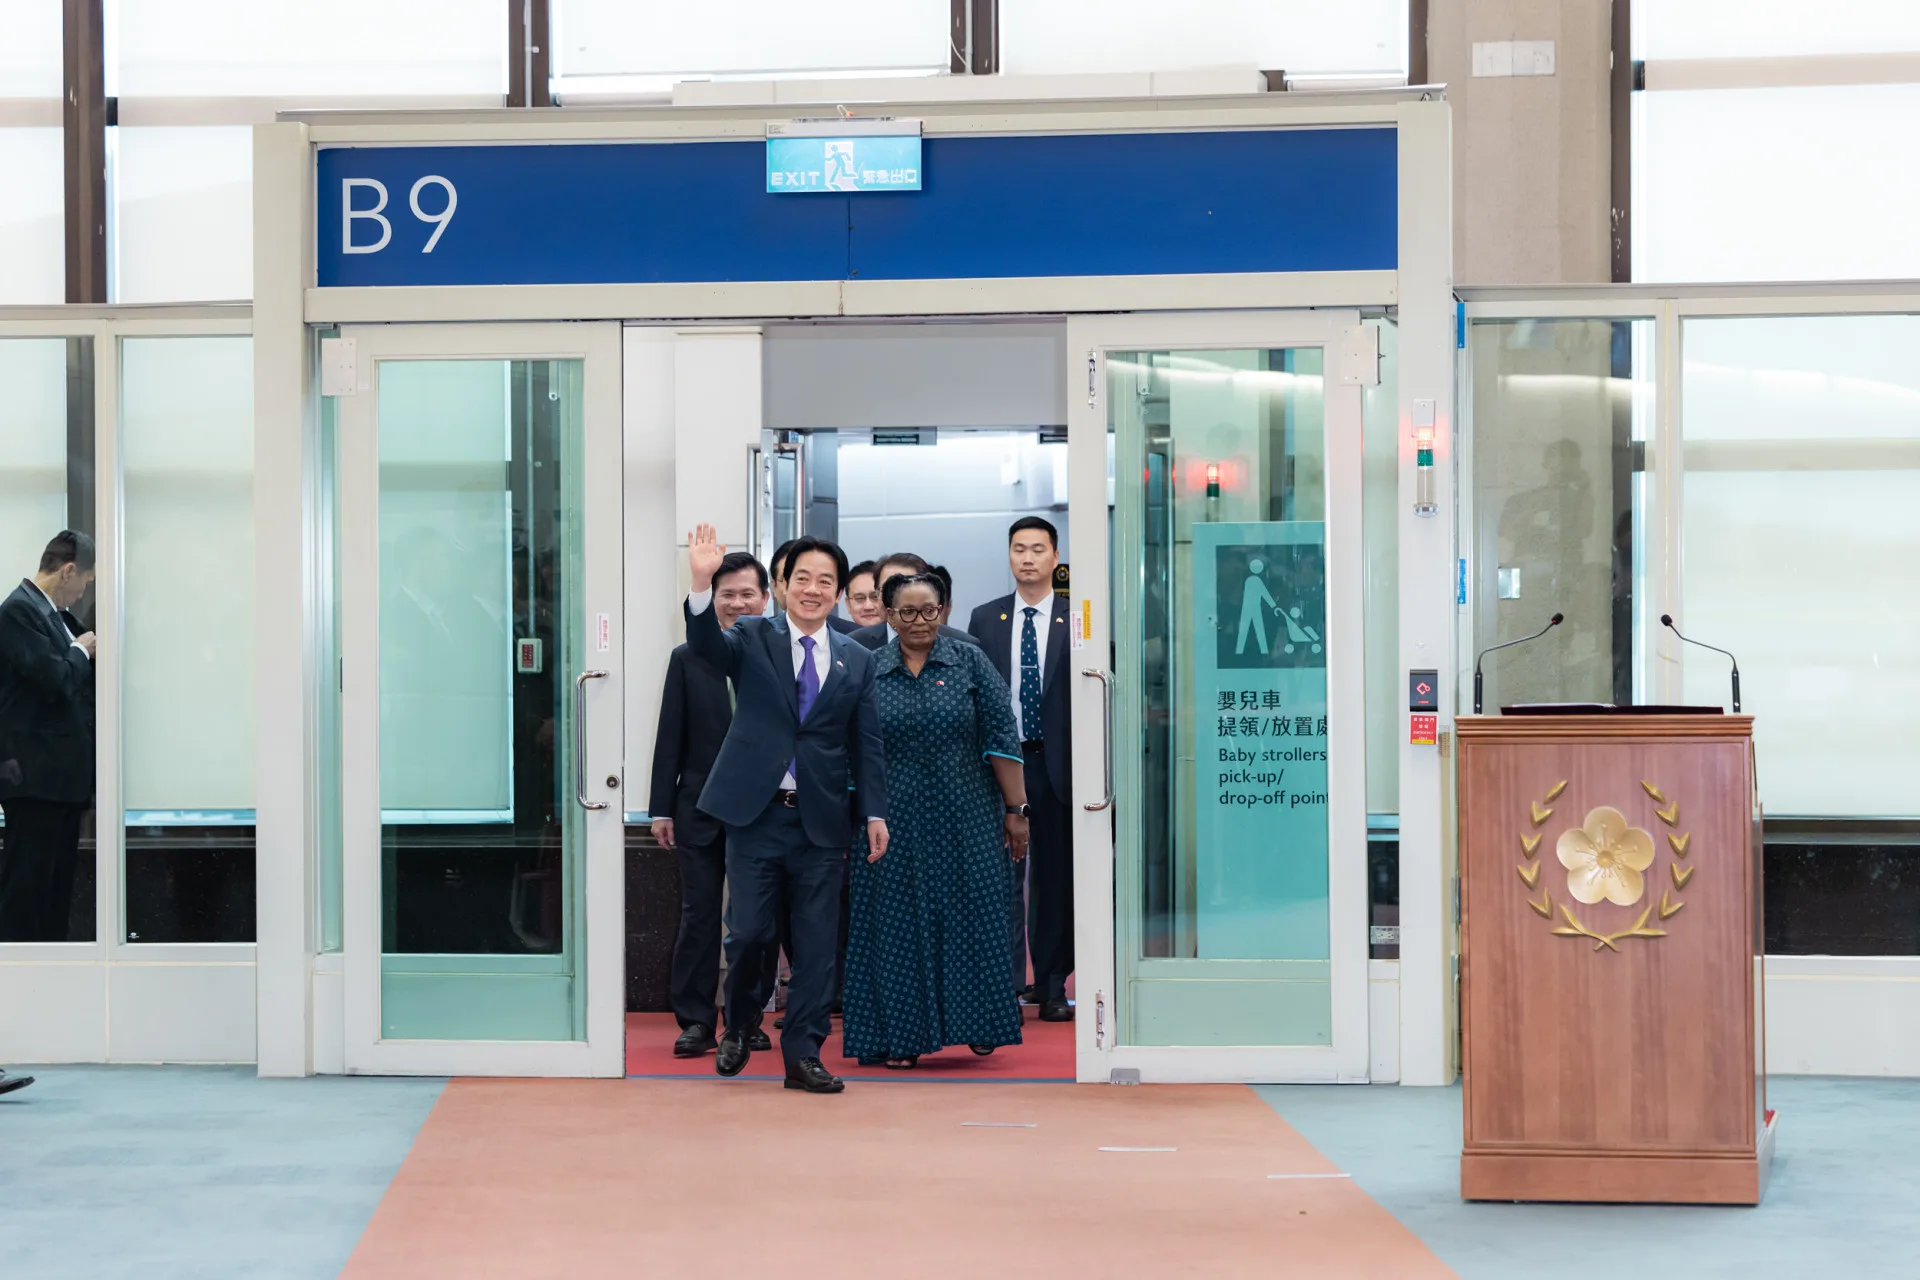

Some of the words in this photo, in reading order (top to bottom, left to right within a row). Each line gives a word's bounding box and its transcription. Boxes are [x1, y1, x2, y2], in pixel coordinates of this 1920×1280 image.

[771, 171, 820, 186] EXIT
[863, 169, 917, 184] 緊急出口
[1217, 690, 1281, 711] 嬰兒車
[1218, 748, 1257, 765] Baby
[1262, 748, 1327, 761] strollers
[1219, 769, 1284, 787] pick-up/
[1219, 791, 1285, 808] drop-off
